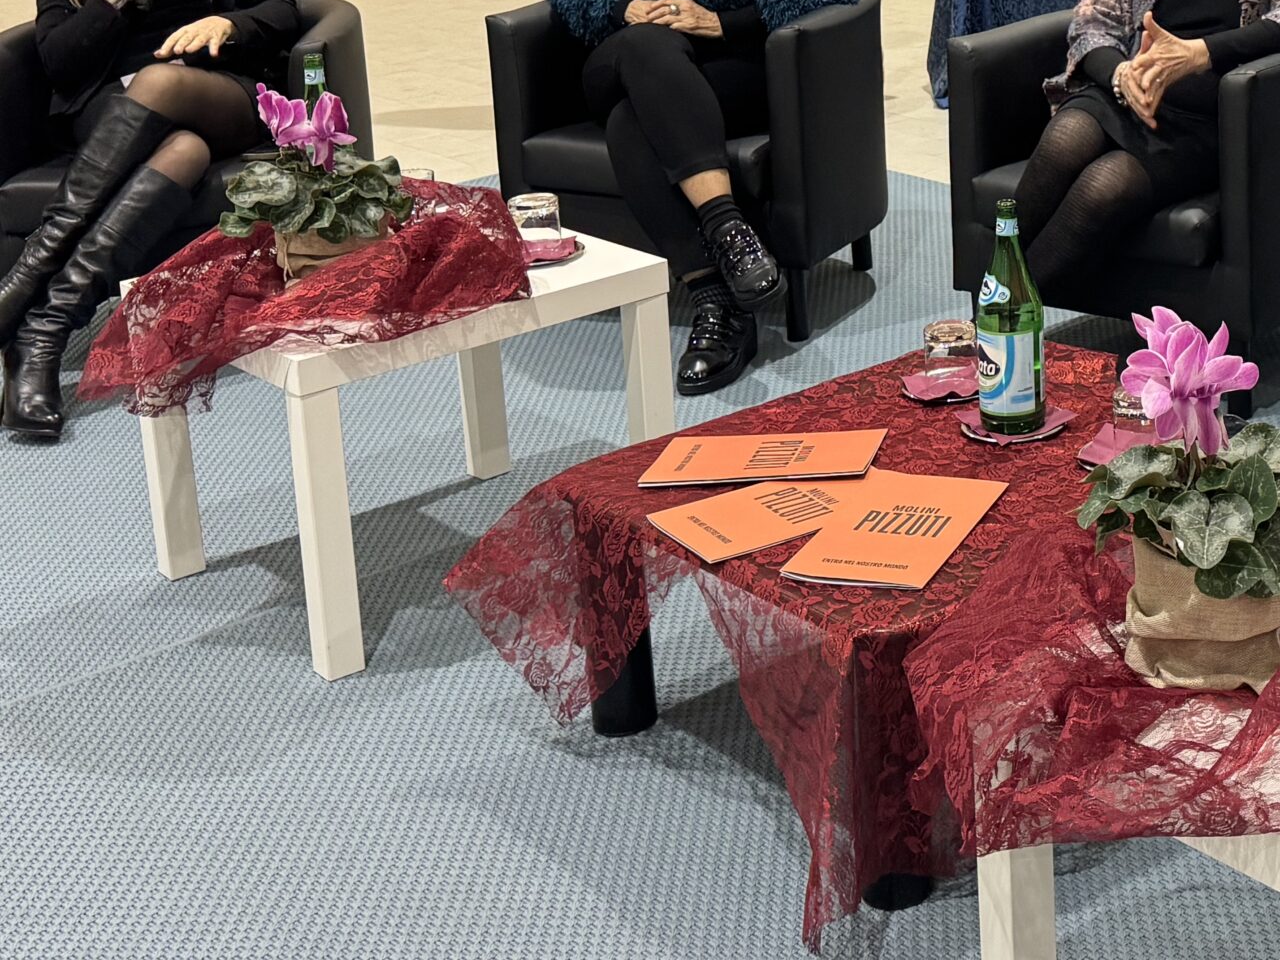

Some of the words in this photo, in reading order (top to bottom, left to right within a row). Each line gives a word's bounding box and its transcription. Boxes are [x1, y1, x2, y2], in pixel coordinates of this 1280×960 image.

[978, 360, 996, 376] ata
[744, 440, 805, 470] PIZZUTI
[754, 486, 835, 525] PIZZUTI
[806, 487, 840, 506] MOLINI
[892, 504, 941, 515] MOLINI
[853, 510, 953, 538] PIZZUTI
[822, 557, 843, 565] ENTRA
[856, 560, 883, 568] NOSTRO
[884, 563, 909, 571] MONDO
